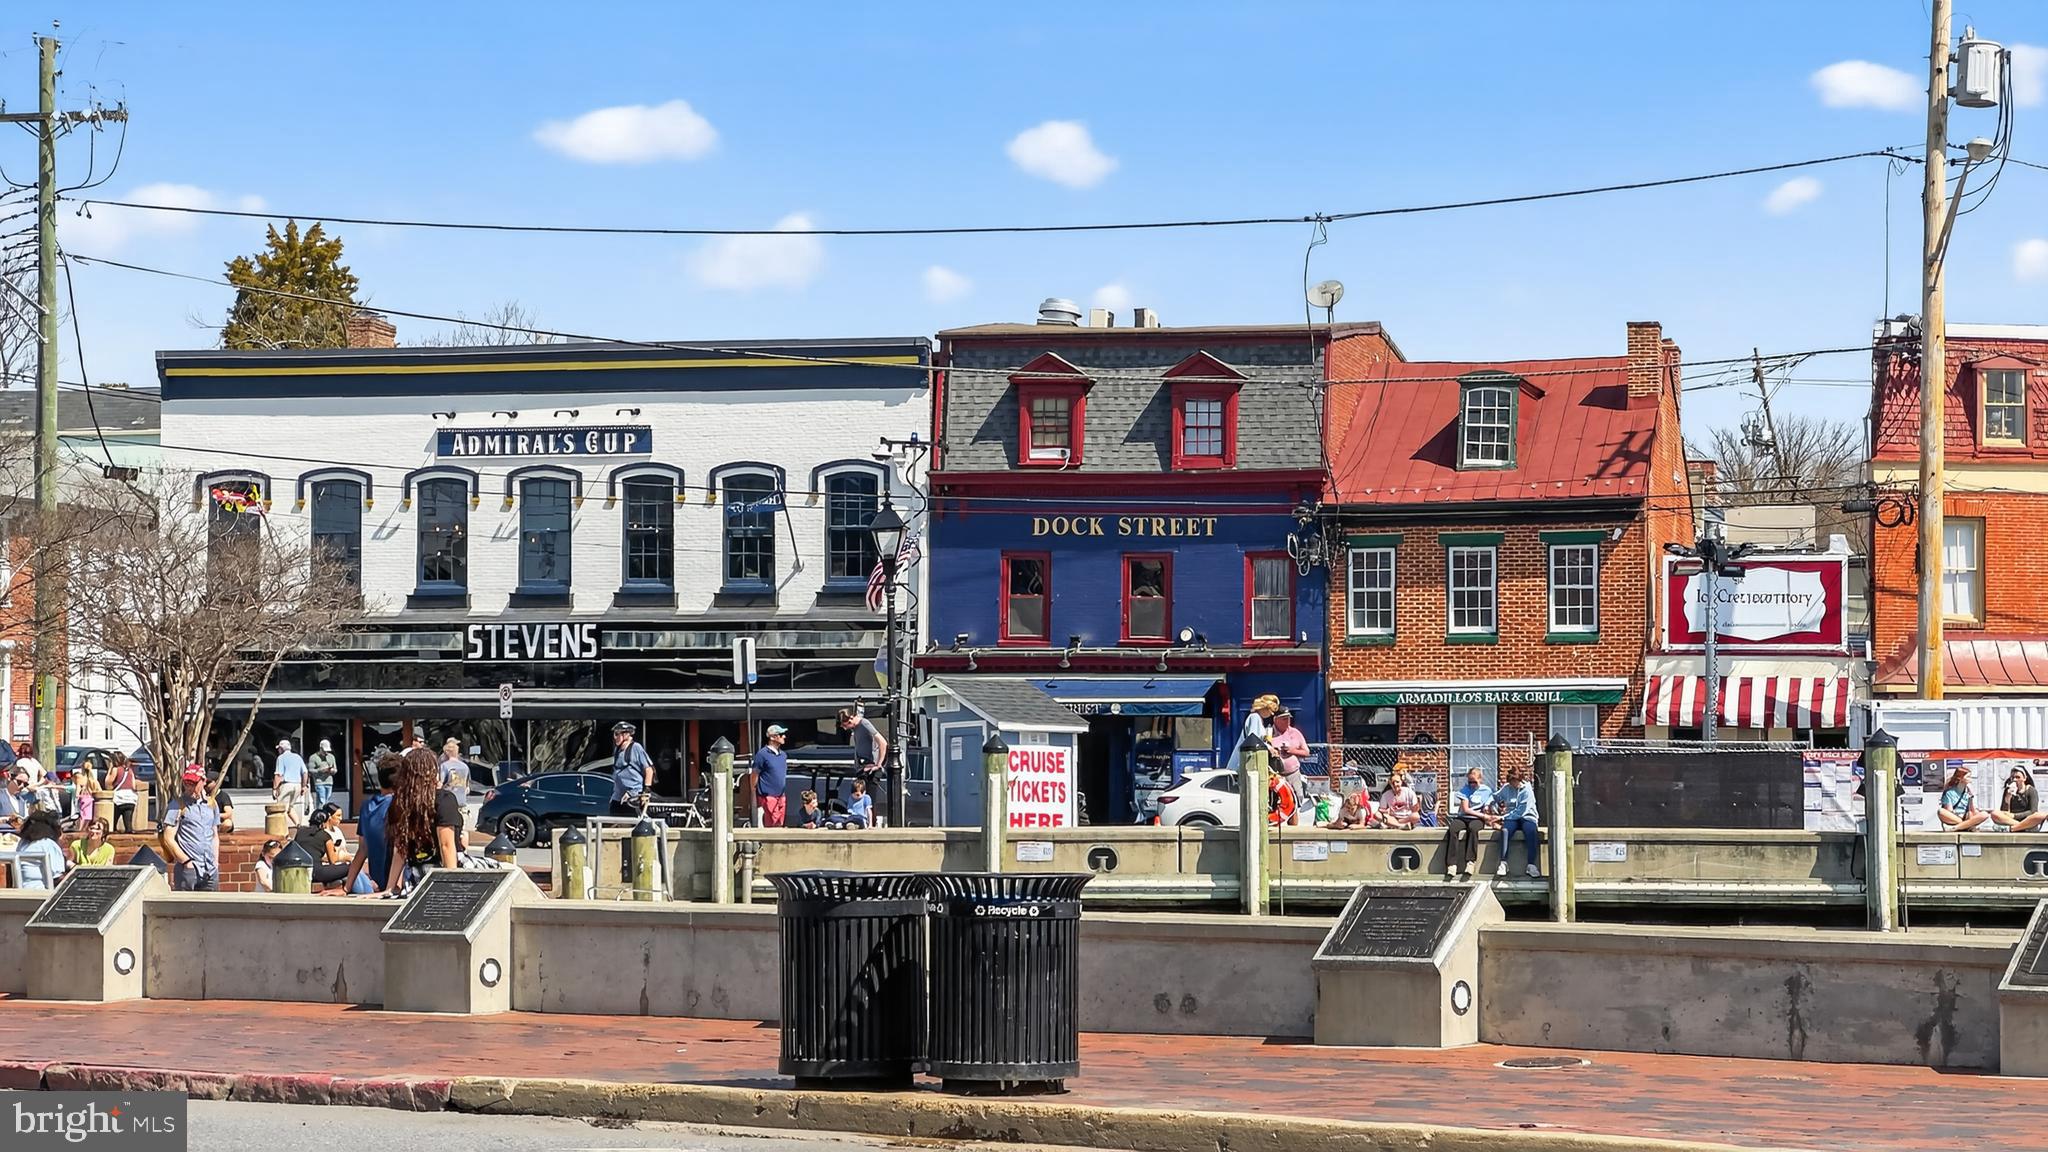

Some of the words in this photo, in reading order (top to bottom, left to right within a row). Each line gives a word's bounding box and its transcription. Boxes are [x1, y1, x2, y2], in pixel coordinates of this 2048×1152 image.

[452, 432, 574, 456] ADMIRAL'S
[585, 431, 637, 454] CUP
[1032, 516, 1104, 536] DOCK
[1118, 516, 1218, 536] STREET
[467, 624, 597, 659] STEVENS
[1396, 692, 1482, 704] ARMADILLO'S
[1485, 692, 1511, 703] BAR
[1512, 692, 1522, 702] &
[1008, 751, 1065, 773] CRUISE
[1008, 781, 1066, 804] TICKETS
[1009, 813, 1063, 828] HERE
[987, 905, 1028, 917] Recycle
